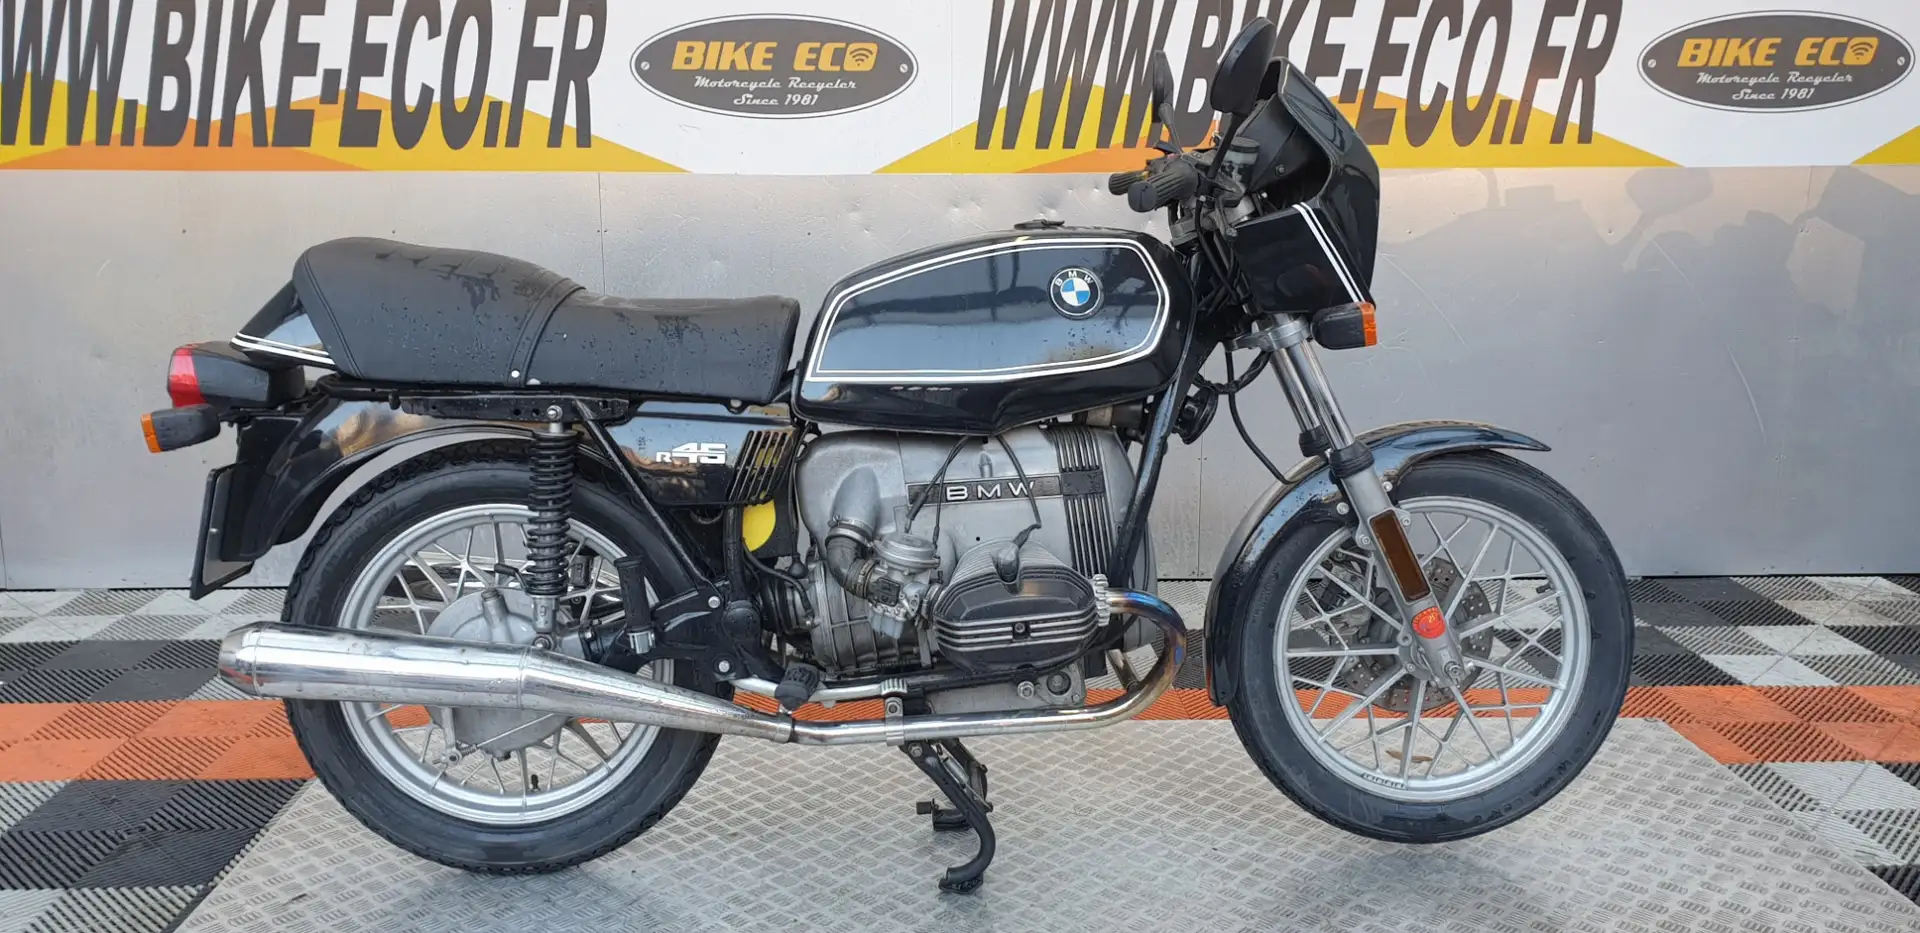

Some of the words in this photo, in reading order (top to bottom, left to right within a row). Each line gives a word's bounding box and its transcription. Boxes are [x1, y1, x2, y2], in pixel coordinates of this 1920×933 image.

[672, 41, 777, 71] BIKE
[793, 42, 878, 71] ECO
[1677, 37, 1782, 67] BIKE
[1794, 37, 1879, 67] ECO
[693, 75, 781, 92] Motorcycle
[788, 76, 857, 92] Recycler
[1696, 71, 1780, 85] Motorcycle
[1787, 71, 1853, 84] Recycler
[733, 94, 779, 106] Since
[784, 94, 819, 106] 1981
[1732, 88, 1775, 100] Since
[1781, 88, 1815, 99] 1981
[1054, 270, 1094, 287] BMW
[946, 481, 1035, 501] BMW
